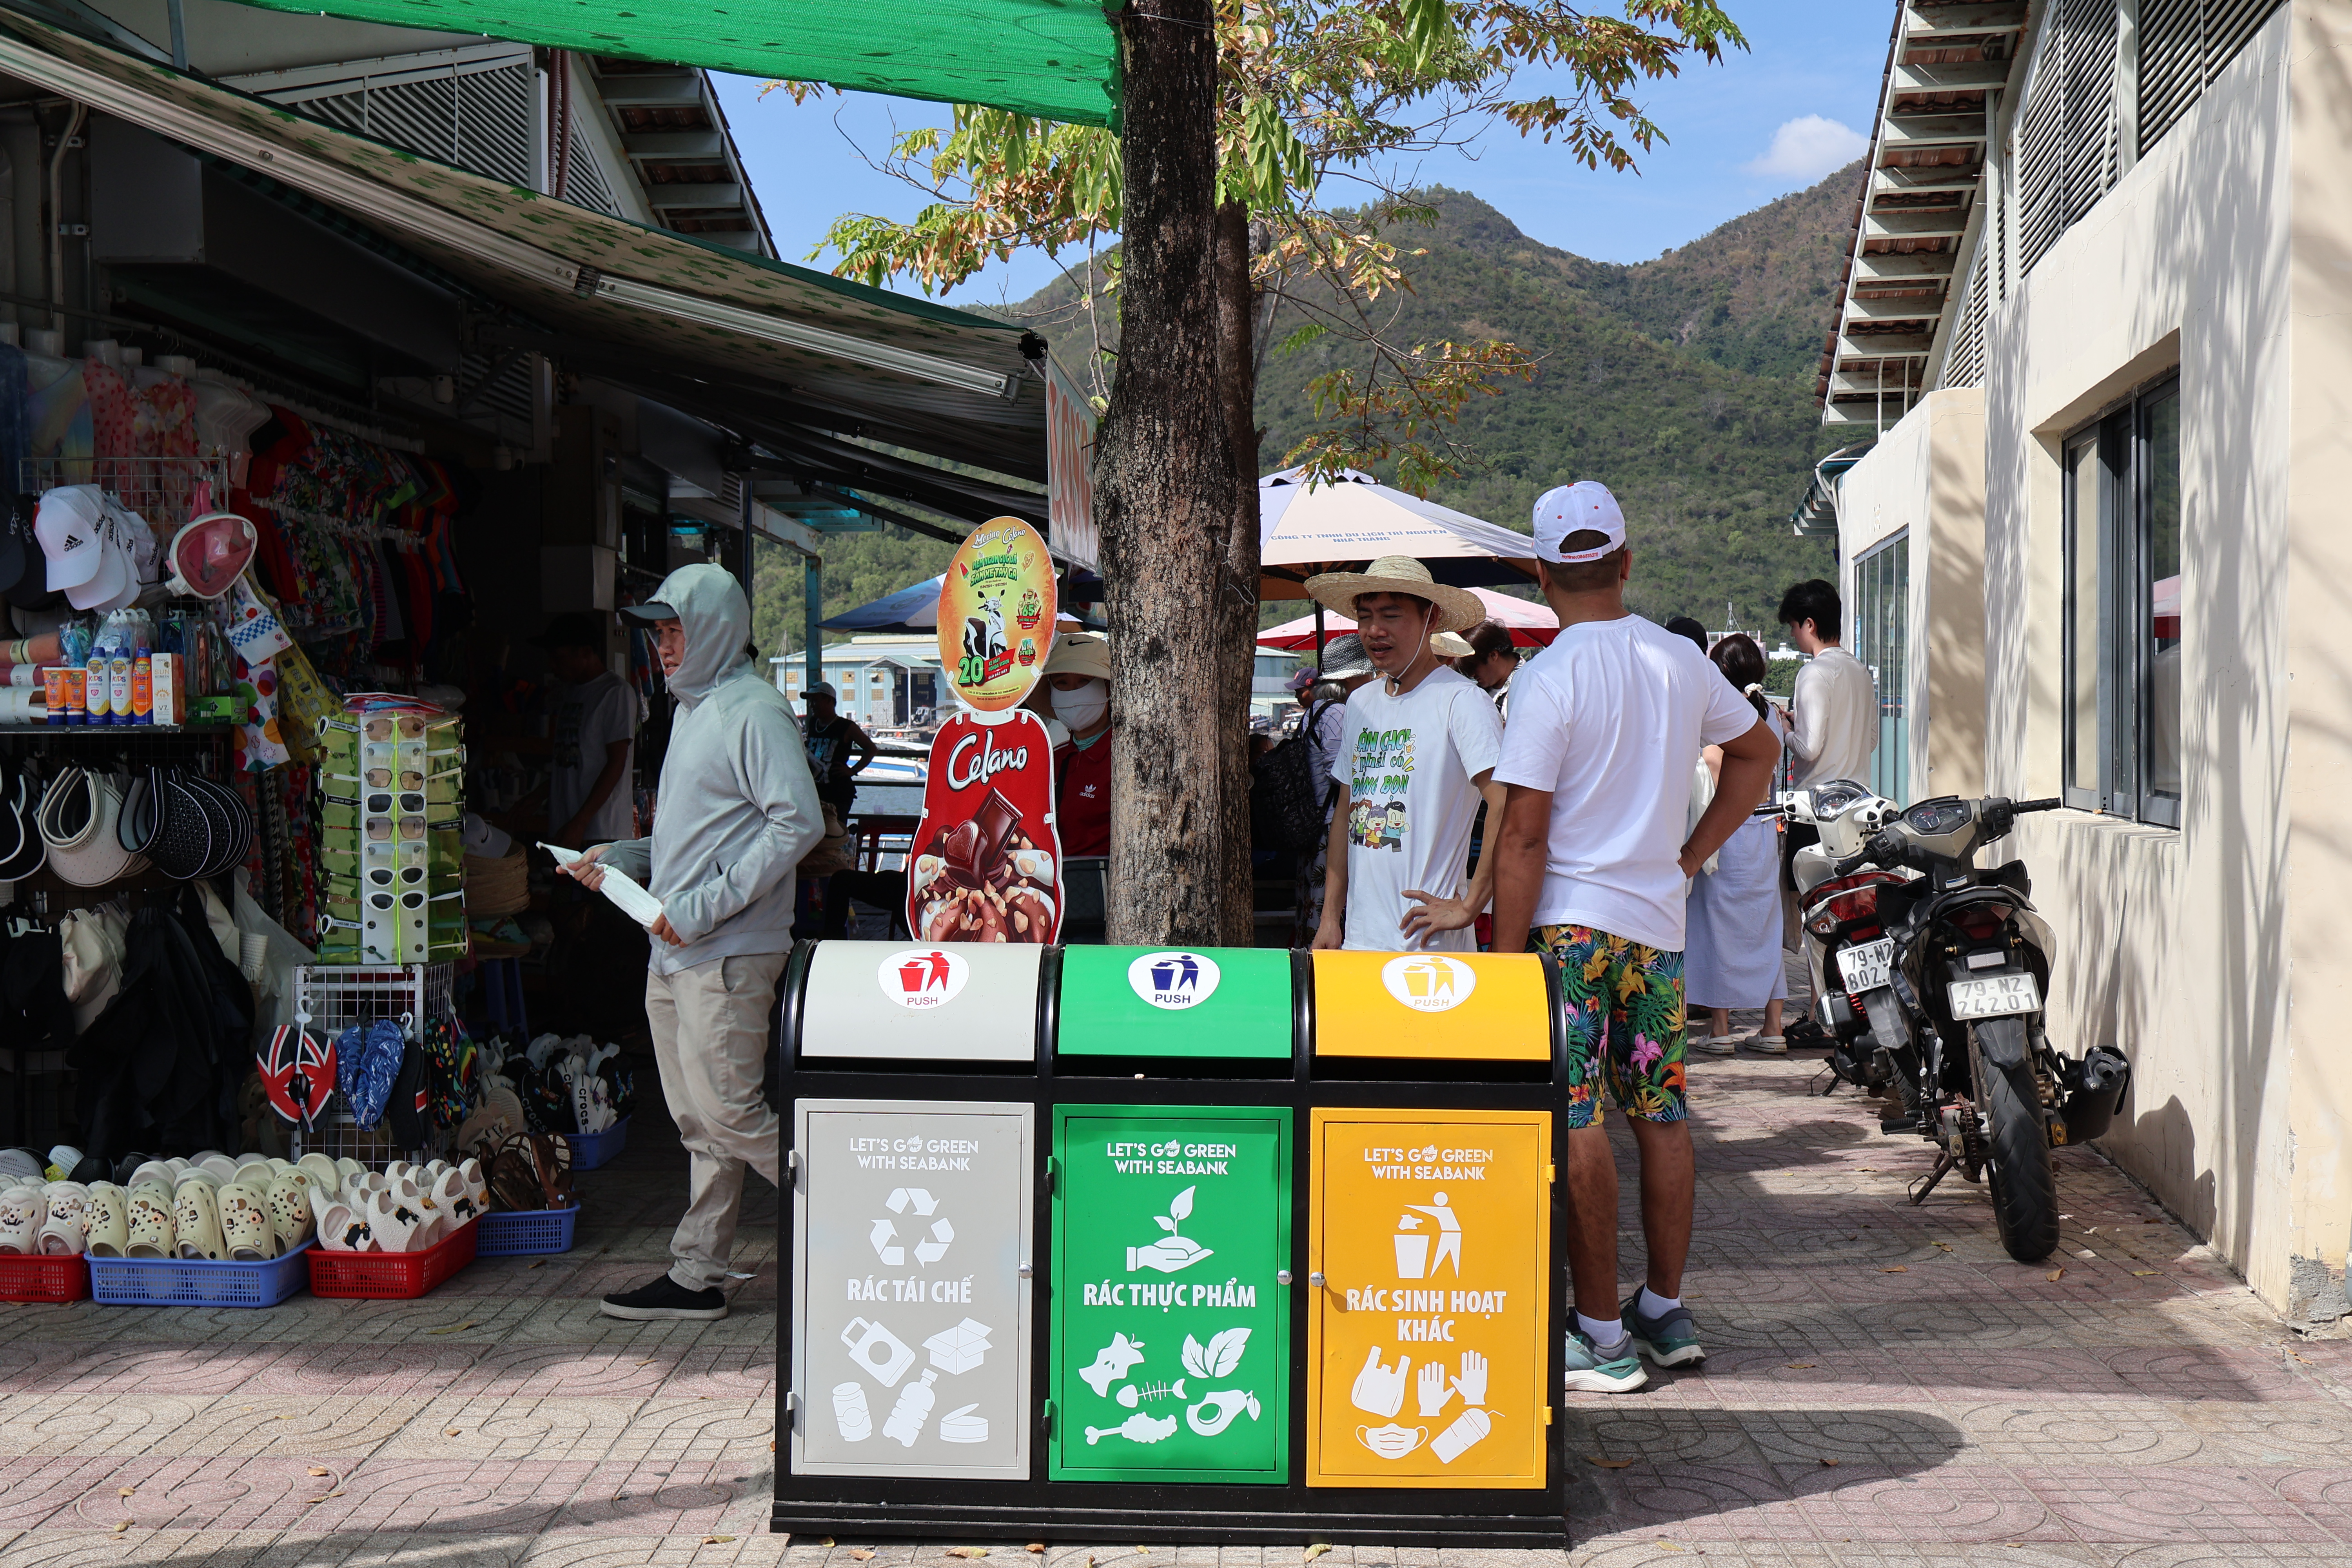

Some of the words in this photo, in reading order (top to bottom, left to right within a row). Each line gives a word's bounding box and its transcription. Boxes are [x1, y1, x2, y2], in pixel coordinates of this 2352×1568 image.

[94, 514, 105, 534] adidas
[974, 529, 1000, 545] Merino
[1002, 526, 1026, 544] Celano
[64, 539, 83, 552] adidas
[984, 554, 999, 567] NGON
[984, 568, 994, 580] XE
[994, 567, 1008, 578] TAY
[1008, 567, 1018, 581] GA
[1022, 604, 1034, 617] 65
[958, 656, 984, 684] 20
[988, 664, 999, 672] HONDA
[999, 659, 1010, 668] VISION
[1357, 727, 1379, 752] ĂN
[947, 728, 1029, 792] Celano
[1390, 750, 1405, 768] có
[1847, 942, 1891, 970] 79-N2
[1847, 963, 1888, 990] 802.
[1961, 977, 2024, 999] 79-N2
[907, 996, 938, 1005] PUSH
[1155, 994, 1191, 1004] PUSH
[1414, 999, 1450, 1007] PUSH
[1957, 992, 2036, 1016] 242.01
[849, 1138, 889, 1152] LET'S
[926, 1139, 978, 1154] GREEN
[1107, 1142, 1147, 1157] LET'S
[1184, 1144, 1236, 1158] GREEN
[857, 1155, 895, 1169] WITH
[900, 1156, 971, 1171] SEABANK
[1364, 1148, 1404, 1162] LET'S
[1441, 1149, 1494, 1163] GREEN
[1114, 1160, 1153, 1174] WITH
[1157, 1160, 1229, 1175] SEABANK
[1371, 1165, 1410, 1180] WITH
[1414, 1166, 1486, 1181] SEABANK
[847, 1274, 888, 1301] RÁC
[892, 1276, 926, 1302] TÁI
[931, 1274, 975, 1304] CHẾ
[1083, 1279, 1125, 1306] RÁC
[1129, 1281, 1187, 1313] THỰC
[1192, 1277, 1256, 1308] PHẨM
[1346, 1284, 1388, 1312] RÁC
[1391, 1289, 1445, 1313] SINH
[1450, 1290, 1507, 1320] HOẠT
[1398, 1315, 1455, 1342] KHÁC
